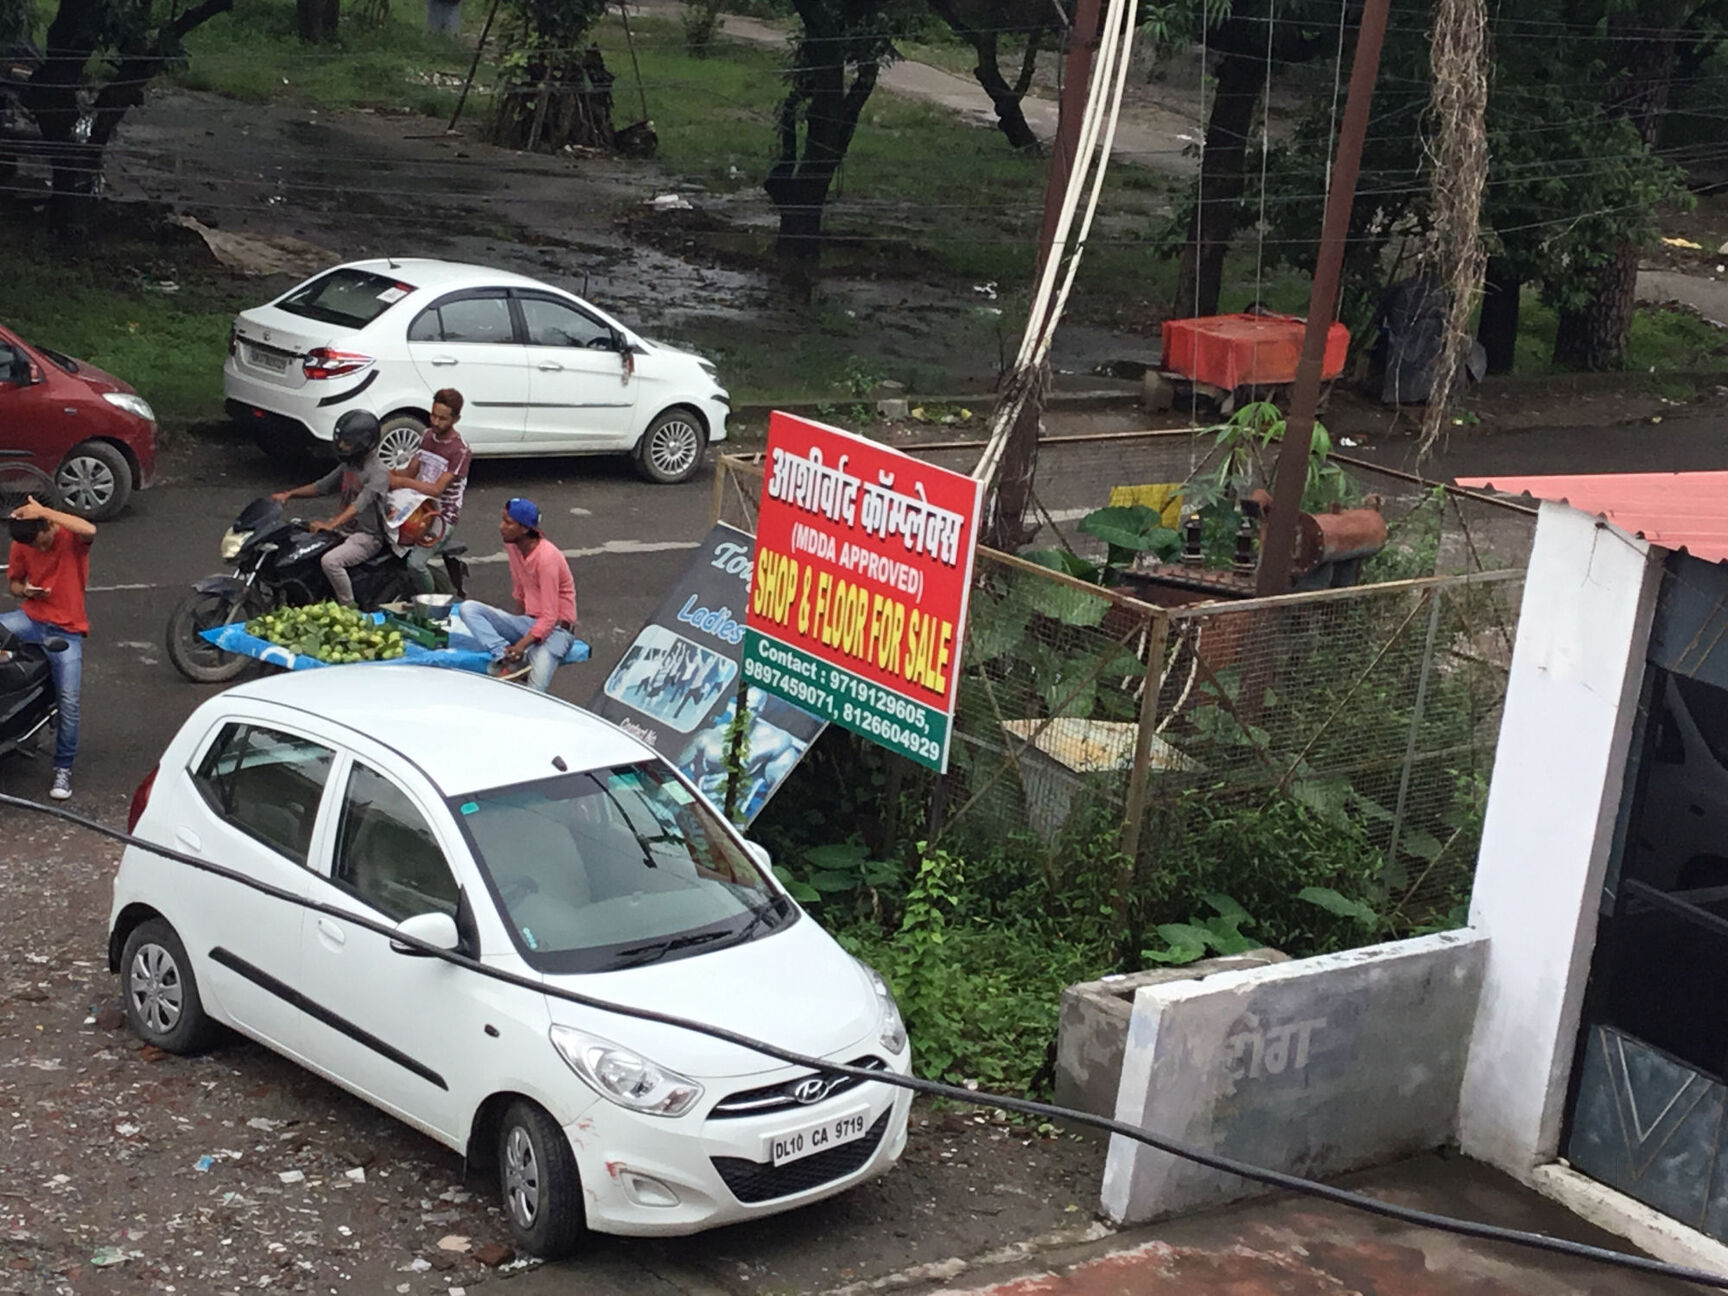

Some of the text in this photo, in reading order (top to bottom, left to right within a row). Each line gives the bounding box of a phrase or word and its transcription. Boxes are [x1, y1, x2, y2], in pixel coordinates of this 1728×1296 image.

[768, 446, 965, 566] आशीर्वाद कॉम्प्लेक्स
[791, 521, 924, 604] (MDDA APPROVED)
[677, 593, 746, 645] Ladies
[754, 546, 953, 694] SHOP & FLOOR FOR SALE
[744, 658, 940, 761] 9897459071, 8126604929
[758, 639, 818, 680] Contact
[829, 670, 930, 734] 9719129605,
[775, 1115, 864, 1160] DL10 CA 9719
